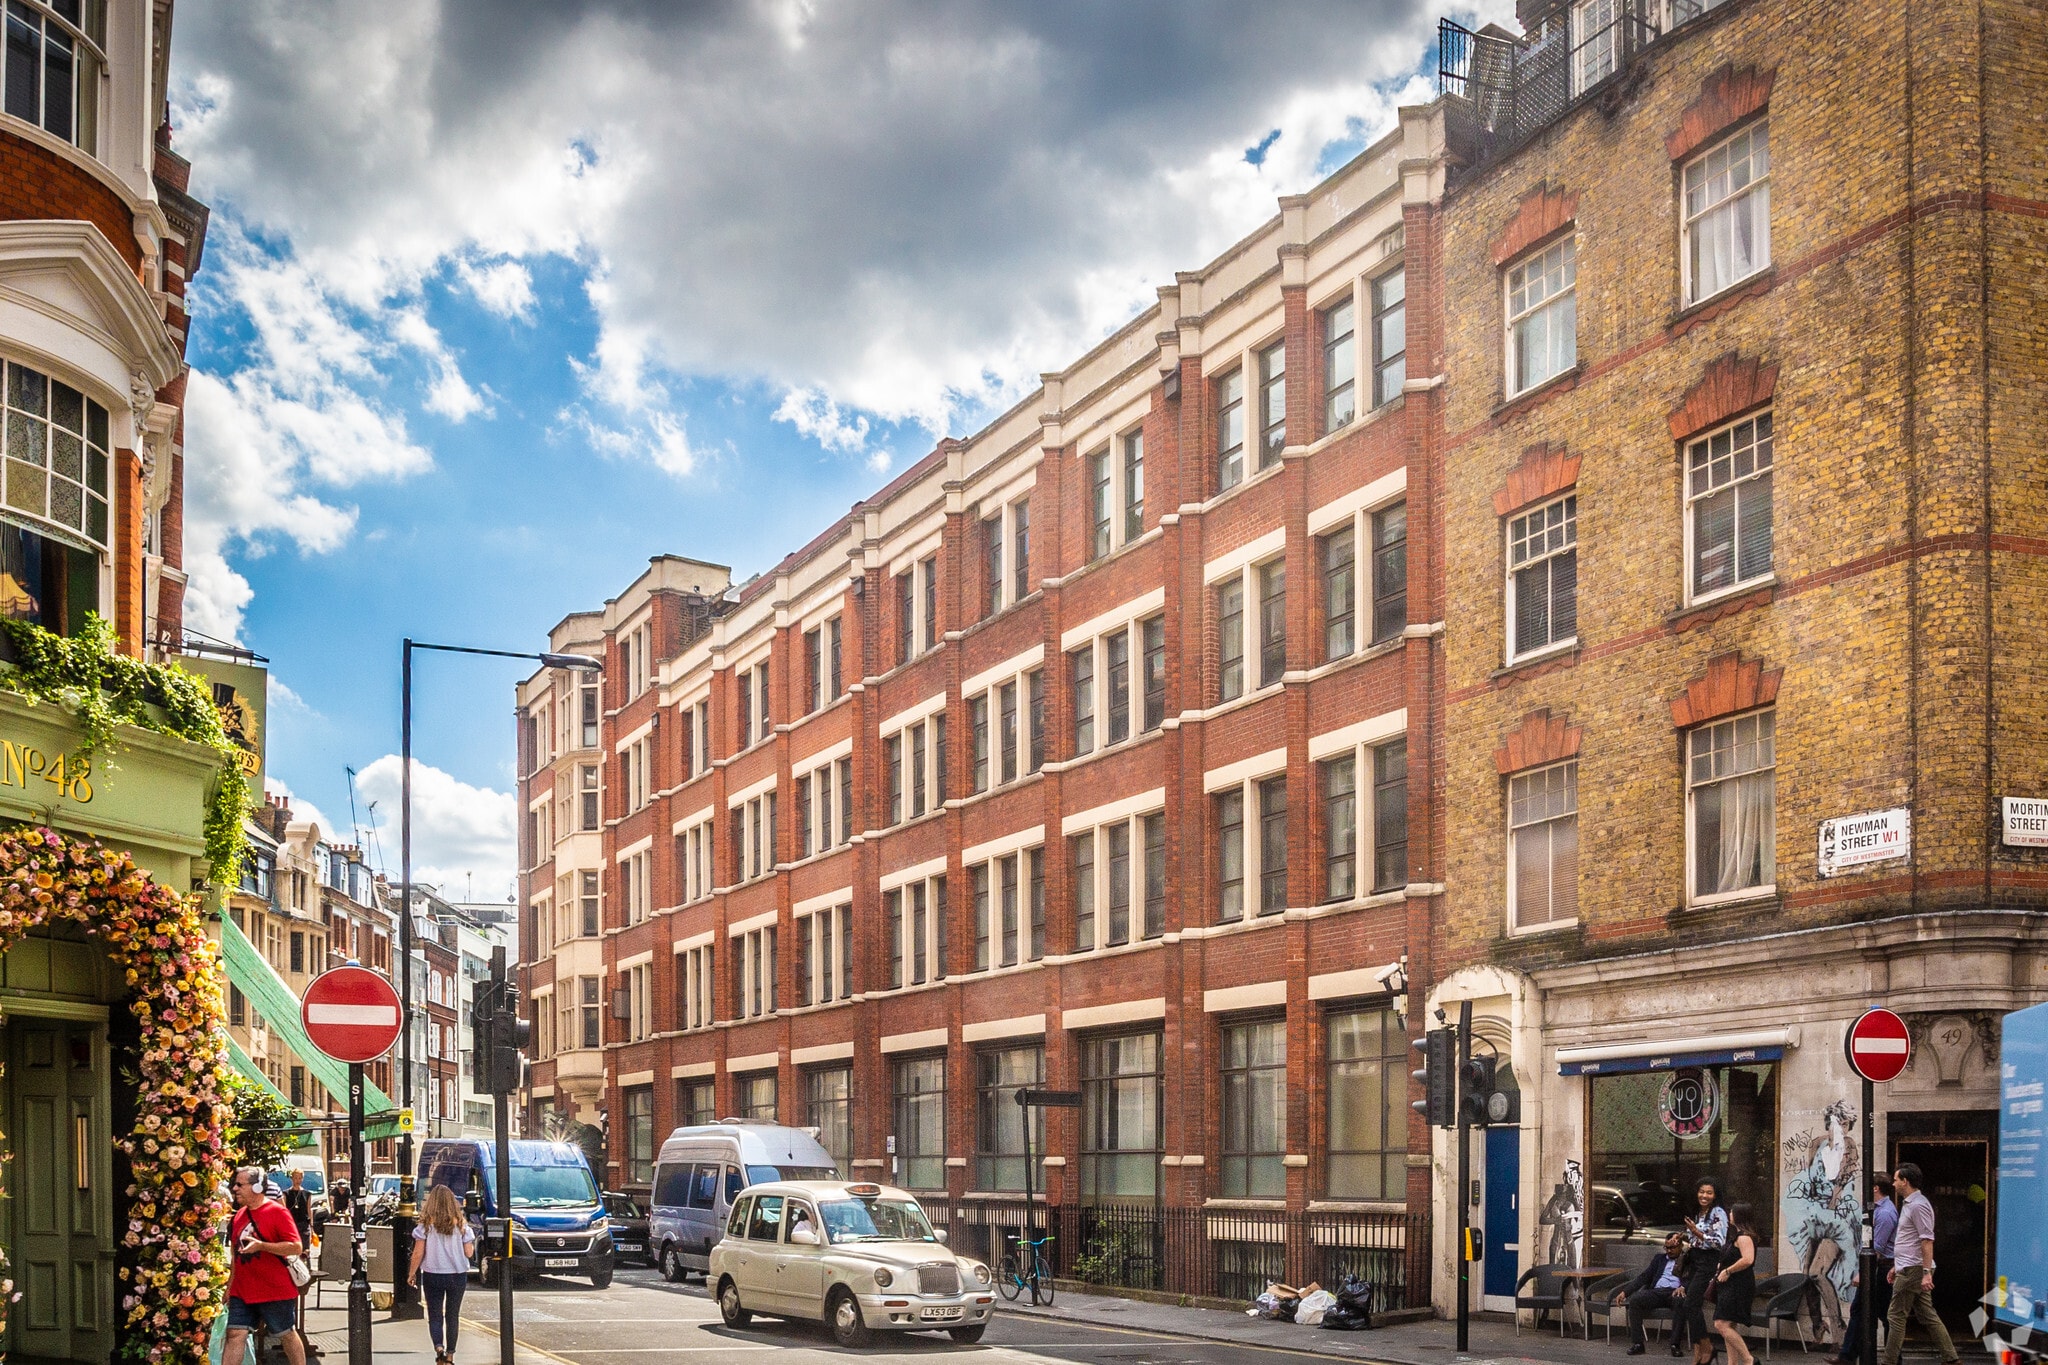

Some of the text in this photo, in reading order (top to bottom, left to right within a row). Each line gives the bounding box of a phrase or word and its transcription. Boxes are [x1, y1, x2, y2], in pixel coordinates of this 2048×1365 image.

[1841, 817, 1888, 837] NEWMAN
[2010, 817, 2047, 831] STREET
[1841, 830, 1899, 851] STREET W1
[1841, 856, 1852, 864] CITY
[1860, 849, 1895, 860] WESTMINSTER
[1941, 1028, 1962, 1047] 49
[351, 1084, 360, 1095] S
[352, 1095, 358, 1105] 1
[924, 1308, 946, 1316] LX53
